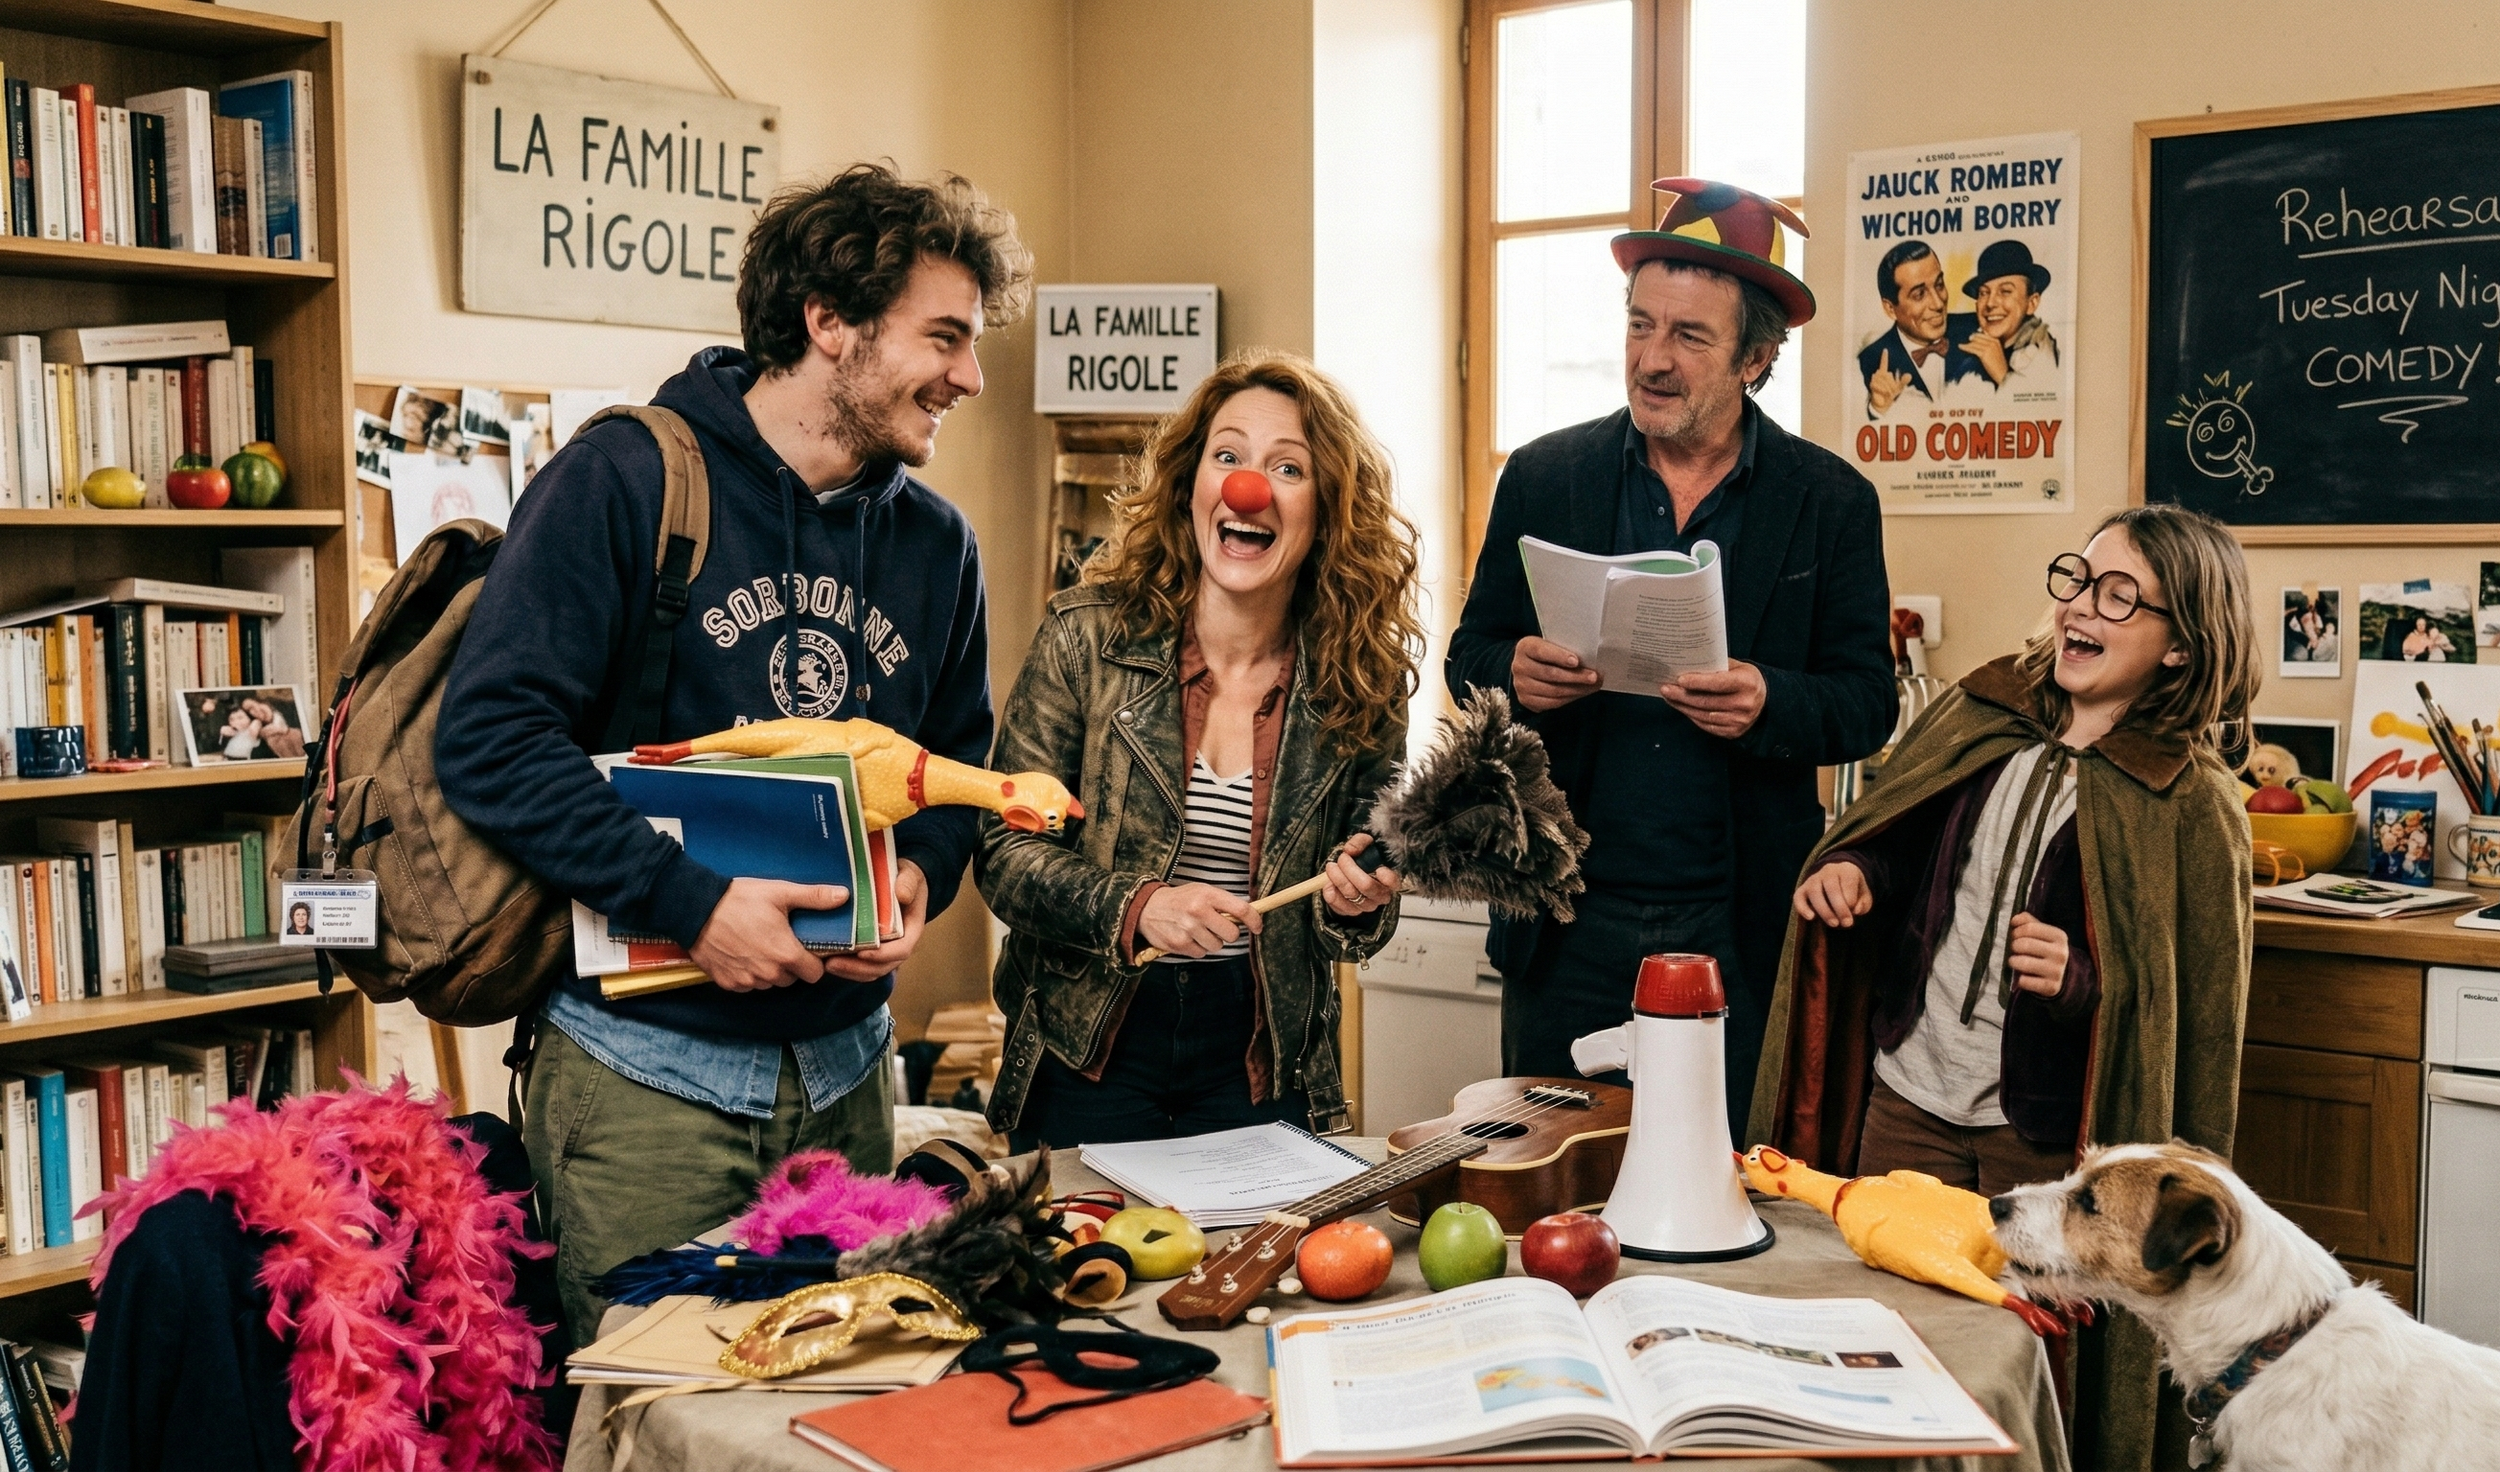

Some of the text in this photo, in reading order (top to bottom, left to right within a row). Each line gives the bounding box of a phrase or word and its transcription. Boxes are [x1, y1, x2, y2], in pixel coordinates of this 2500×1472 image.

[494, 107, 553, 177] LA
[1861, 169, 1940, 200] JAUCK
[1945, 195, 1970, 204] AND
[1861, 199, 2062, 240] WICHOM BORRY
[1050, 306, 1200, 336] LA FAMILLE
[2259, 276, 2419, 335] Tuesday
[1068, 355, 1178, 391] RIGOLE
[2306, 342, 2483, 390] COMEDY
[1855, 420, 2062, 463] OLD COMEDY
